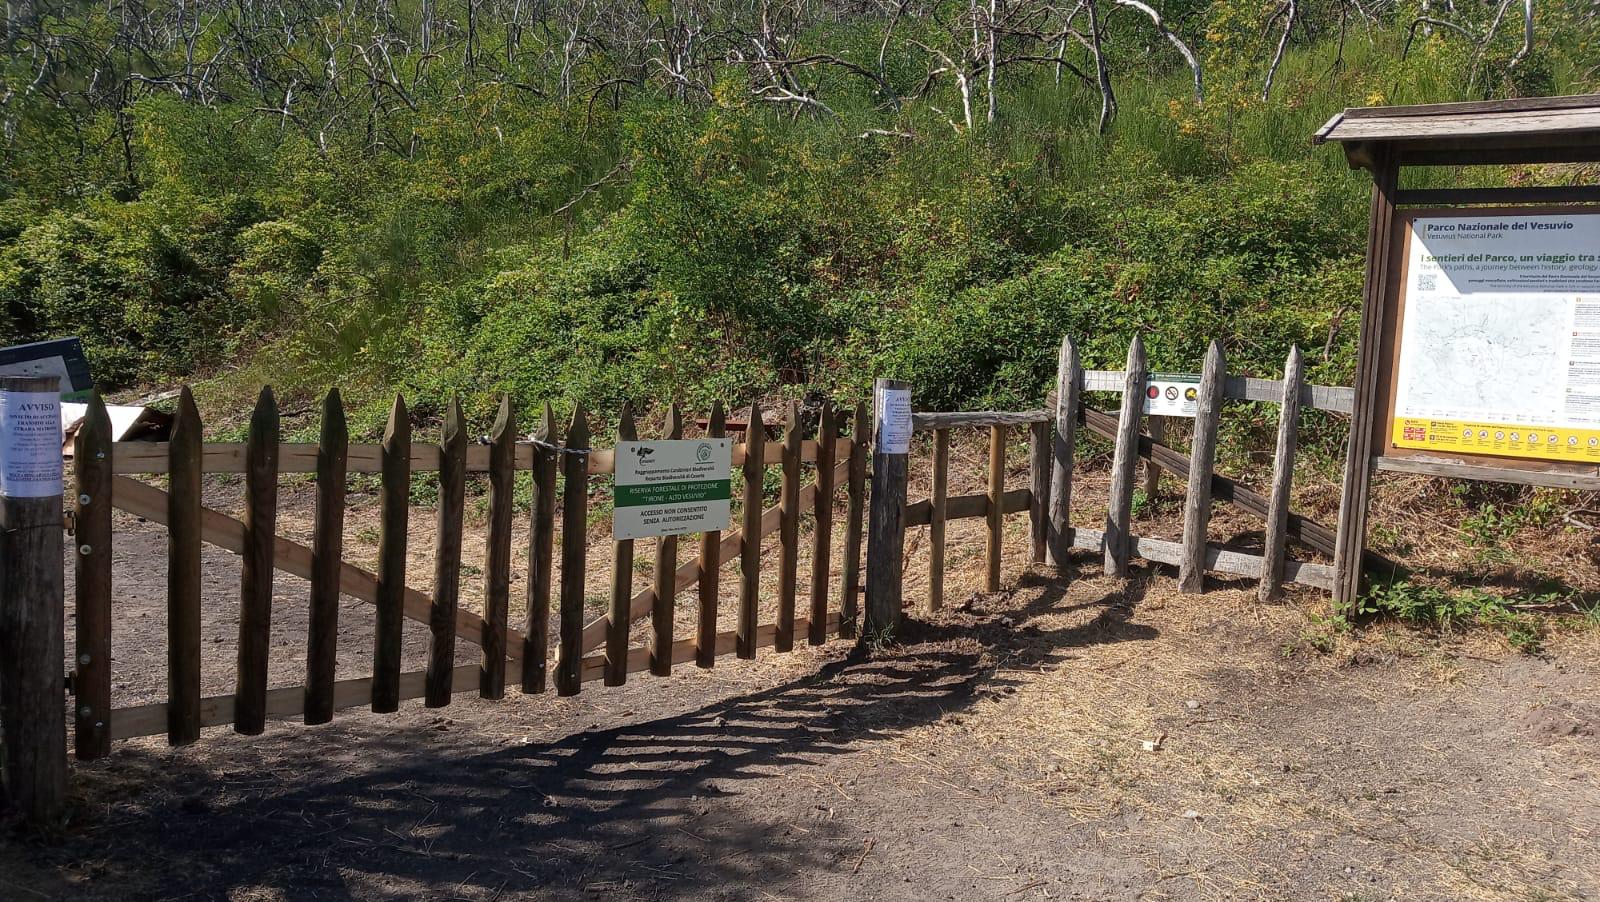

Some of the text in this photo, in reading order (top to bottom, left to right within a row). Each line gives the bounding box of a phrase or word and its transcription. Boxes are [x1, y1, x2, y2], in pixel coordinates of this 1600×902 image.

[1427, 221, 1574, 231] Parco Nazionale del Vesuvio
[1426, 253, 1465, 262] sentieri
[1467, 253, 1483, 262] del
[1485, 254, 1517, 263] Parco,
[1536, 253, 1576, 264] viaggio
[1578, 253, 1595, 262] tra
[1454, 263, 1474, 271] paths,
[1480, 263, 1508, 272] journey
[1509, 263, 1540, 271] between
[1569, 263, 1598, 271] geology
[19, 403, 54, 411] AVVISO
[653, 485, 680, 493] FORESTALE
[688, 483, 719, 491] PROTEZIONE
[669, 493, 682, 501] ALTO
[640, 509, 664, 517] ACCESSO
[677, 506, 708, 514] CONSENTITO
[662, 514, 705, 523] AUTORIZZAZIONE
